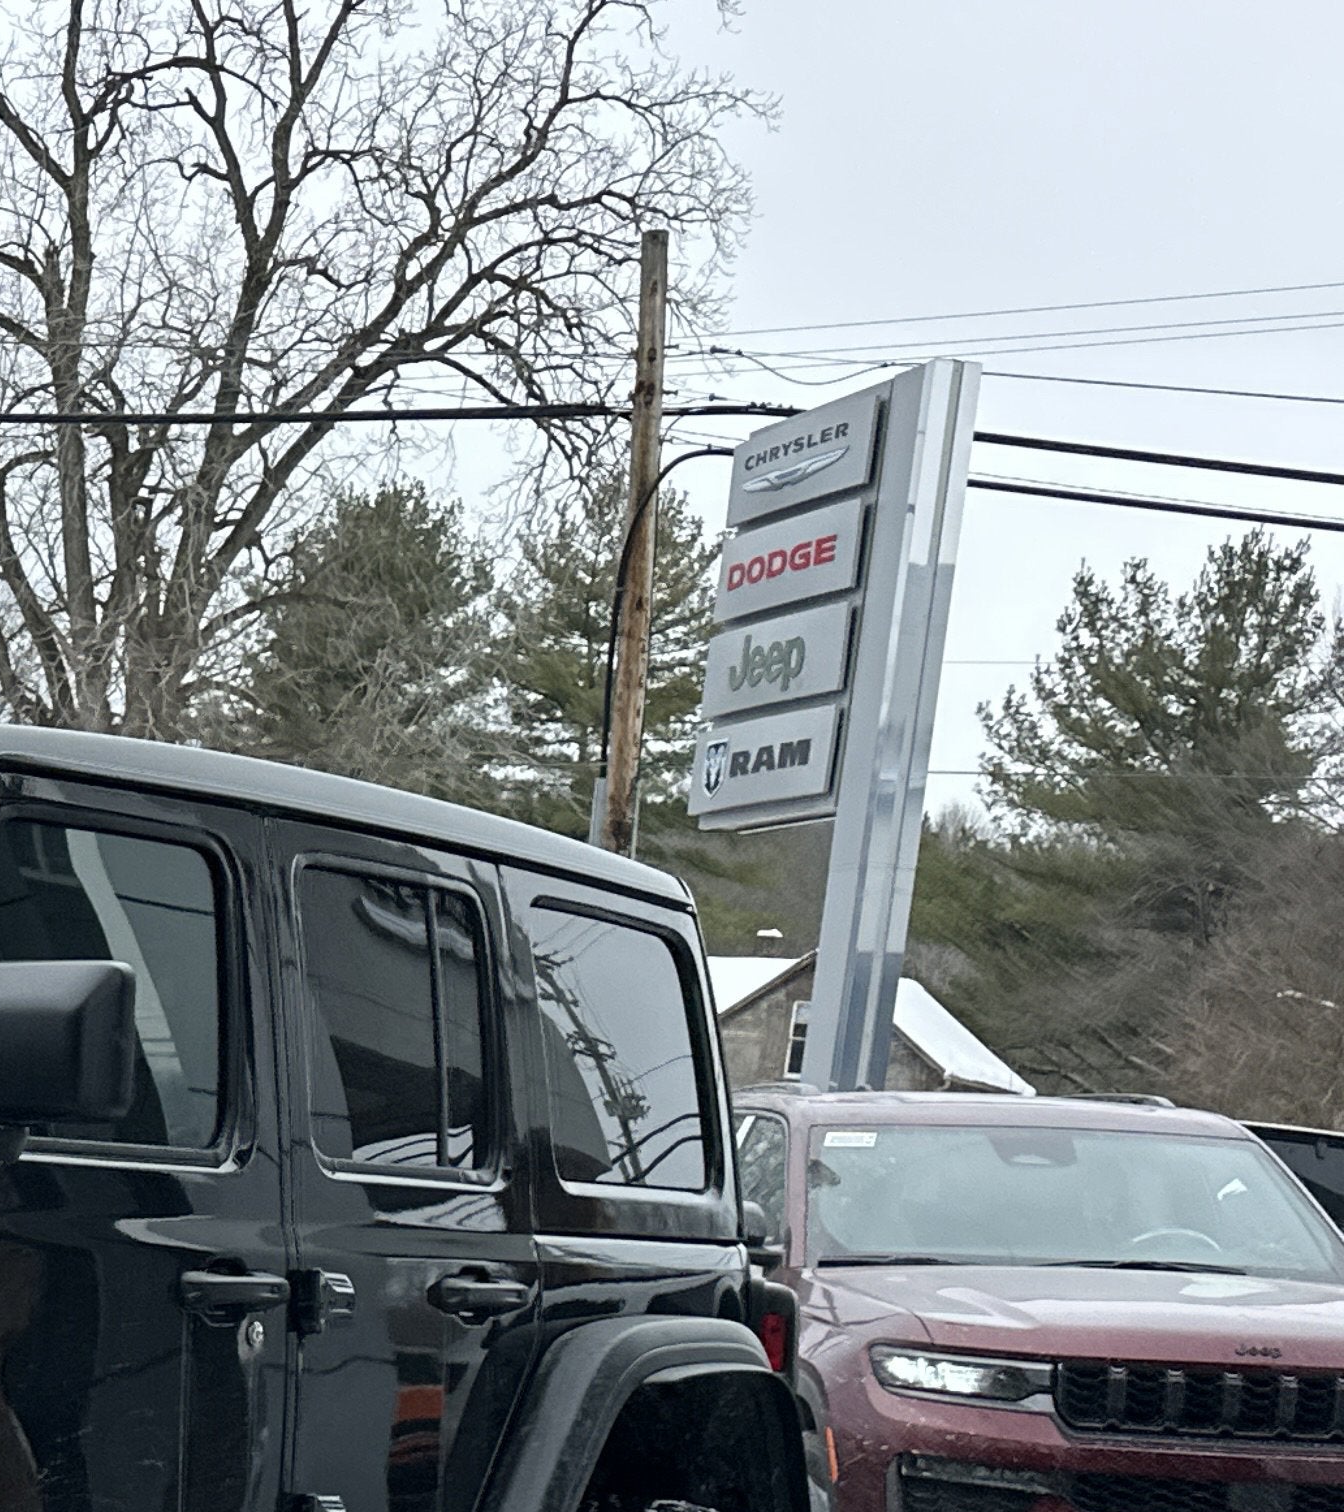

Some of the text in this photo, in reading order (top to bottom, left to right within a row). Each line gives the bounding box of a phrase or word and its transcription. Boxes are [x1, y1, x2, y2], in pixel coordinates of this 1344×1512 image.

[744, 422, 849, 471] CHRYSLER
[727, 534, 838, 592] DODGE
[728, 634, 805, 692] Jeep
[729, 738, 811, 778] RAM
[1234, 1343, 1282, 1360] Jeep
